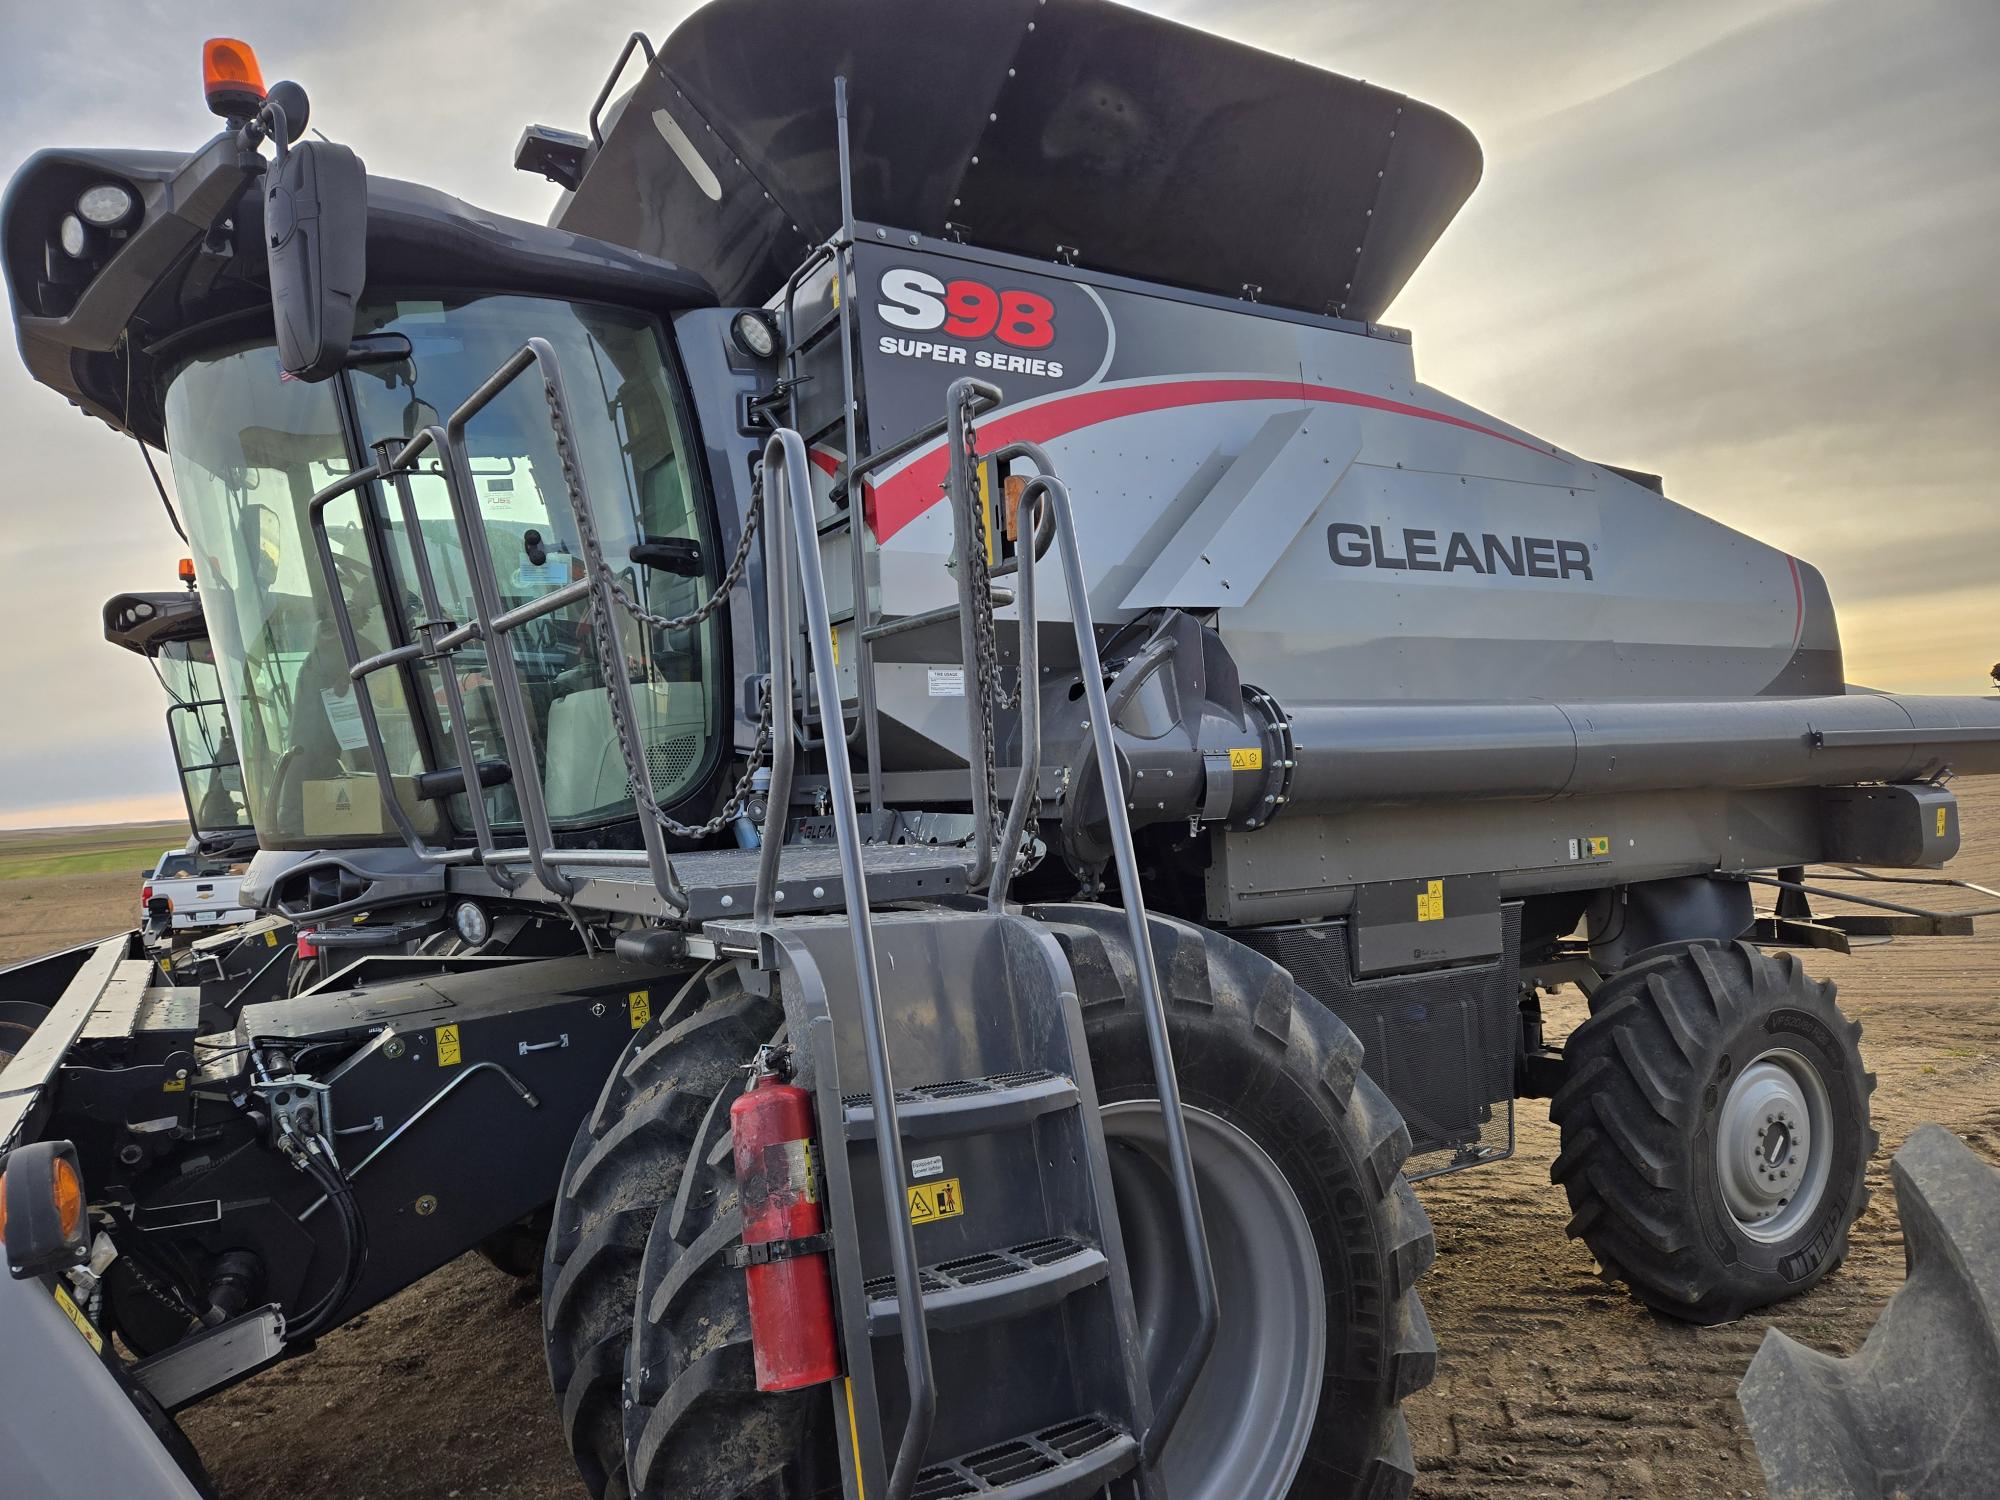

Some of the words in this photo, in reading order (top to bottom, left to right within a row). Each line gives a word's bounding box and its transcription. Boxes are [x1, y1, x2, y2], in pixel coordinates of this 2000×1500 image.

[877, 268, 1055, 348] S98
[878, 336, 967, 365] SUPER
[974, 350, 1064, 378] SERIES
[1326, 522, 1594, 581] GLEANER
